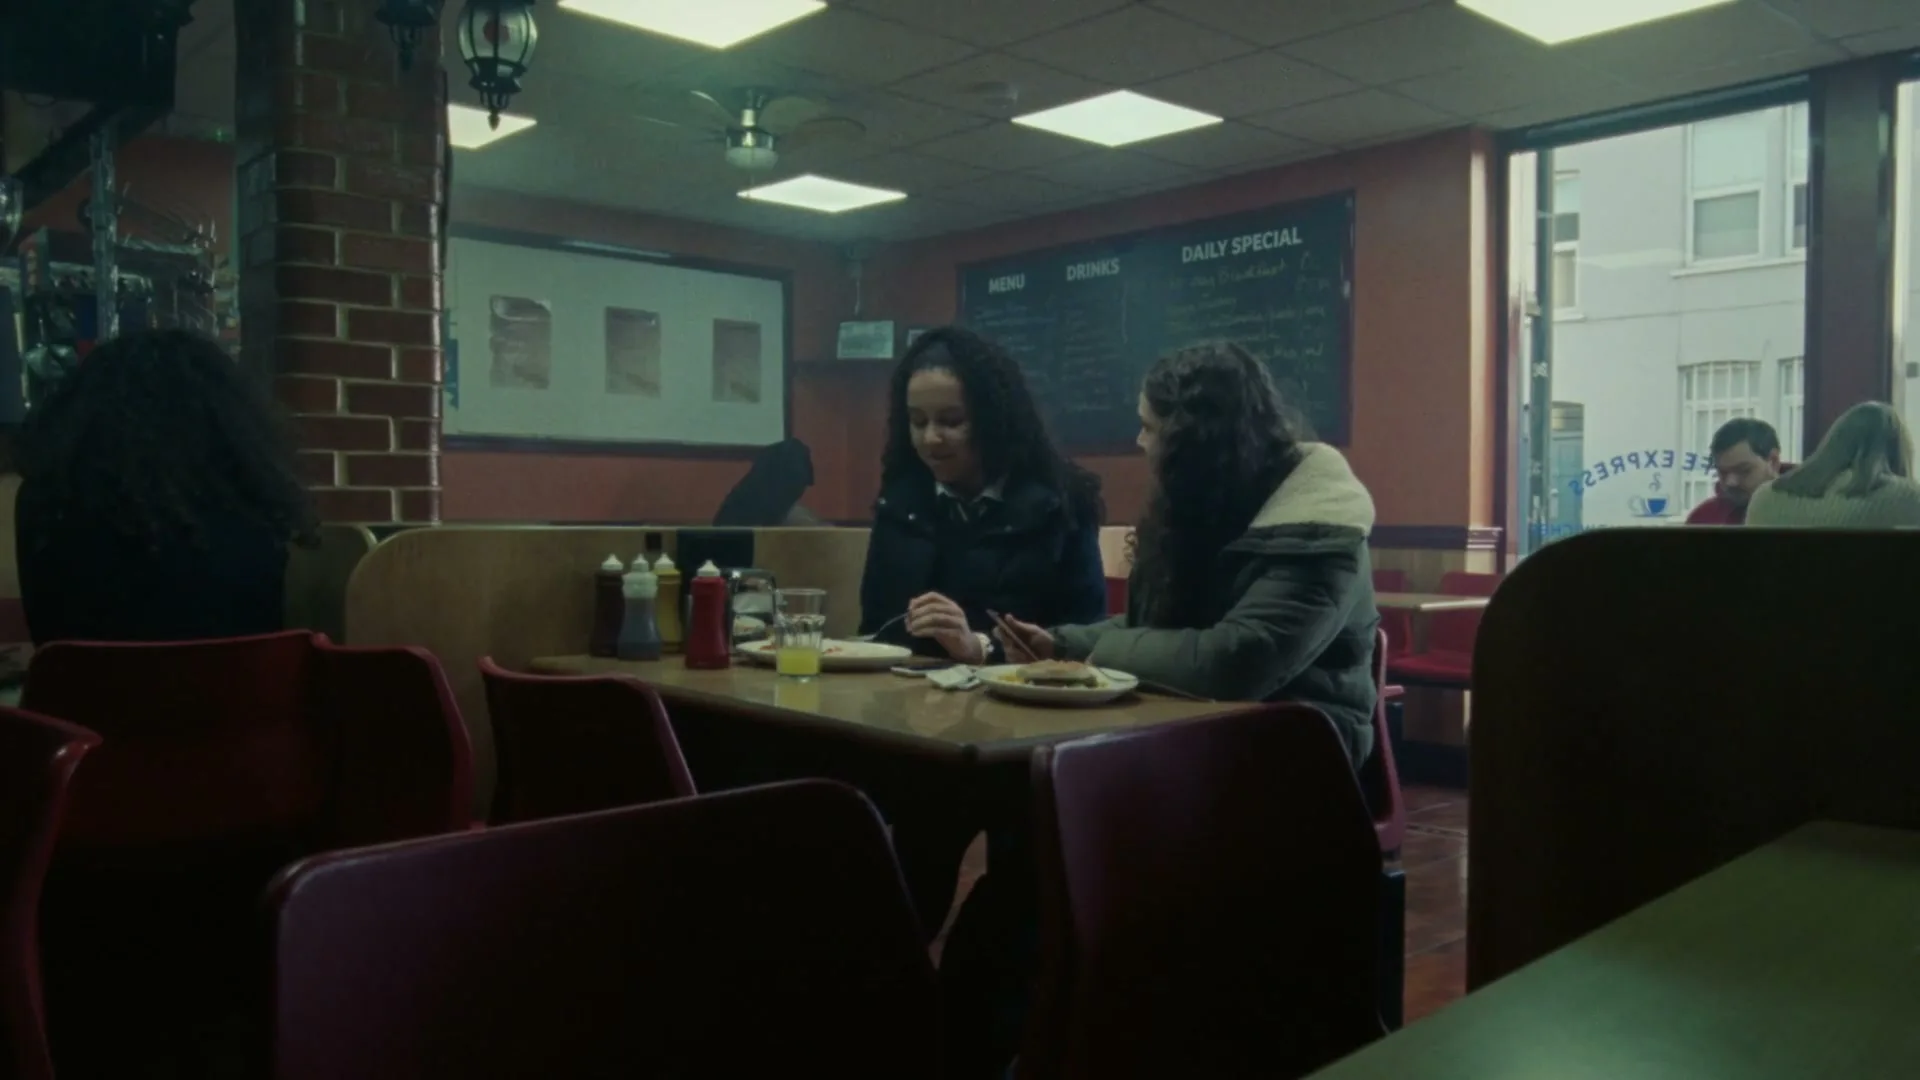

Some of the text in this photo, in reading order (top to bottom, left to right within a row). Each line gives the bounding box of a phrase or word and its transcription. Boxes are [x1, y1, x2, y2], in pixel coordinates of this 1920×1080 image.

[1182, 226, 1303, 263] DAILY SPECIAL
[1066, 257, 1120, 281] DRINKS
[988, 273, 1026, 295] MENU
